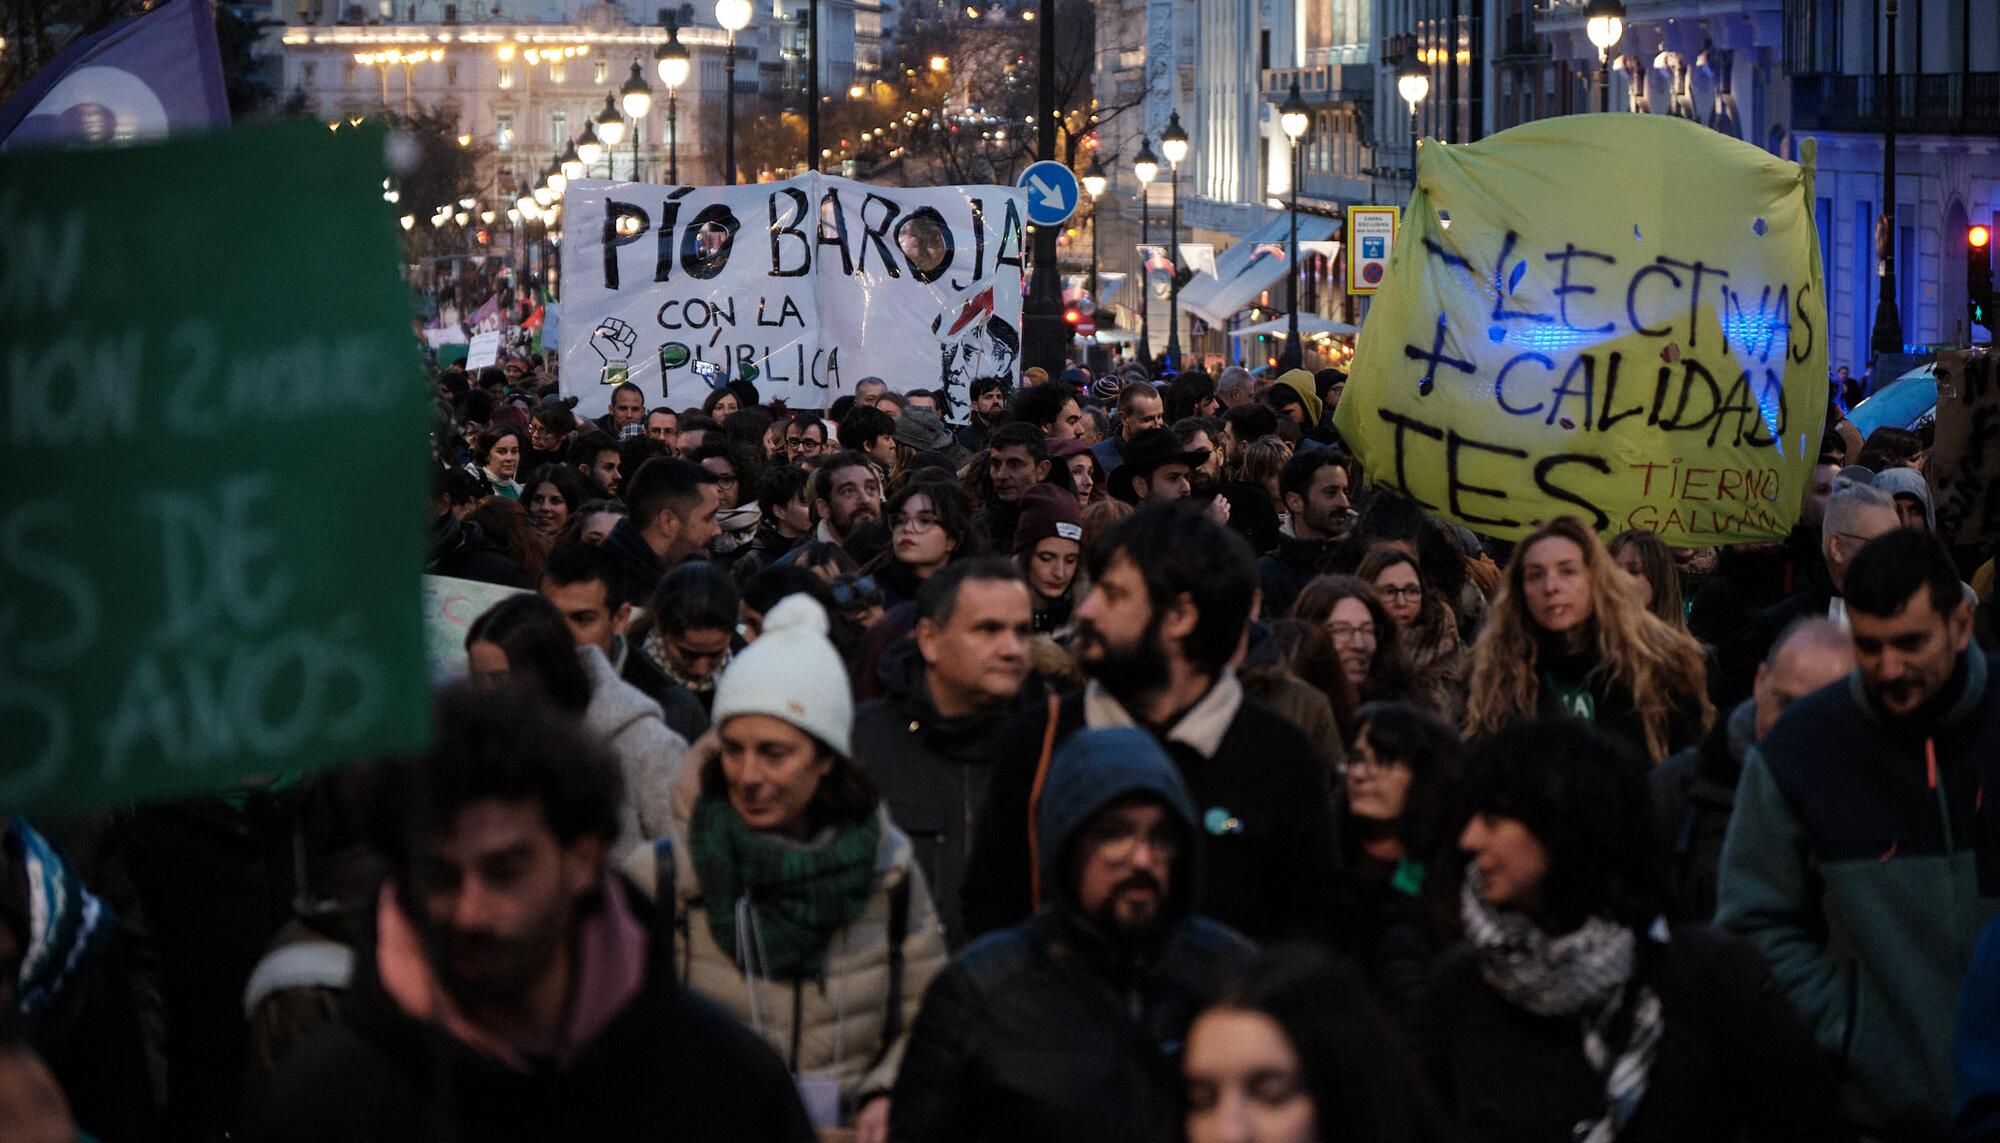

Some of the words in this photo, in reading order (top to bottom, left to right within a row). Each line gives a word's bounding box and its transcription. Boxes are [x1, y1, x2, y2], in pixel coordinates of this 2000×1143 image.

[602, 186, 741, 290] PÍO
[768, 186, 1026, 291] BAROJA
[657, 296, 736, 330] CON
[757, 294, 805, 328] LA
[1492, 230, 1813, 365] LECTIVAS
[658, 326, 840, 398] PÚBLICA
[1495, 351, 1787, 447] CALIDAD
[1378, 408, 1611, 531] TES
[1628, 502, 1776, 535] GALVÁN
